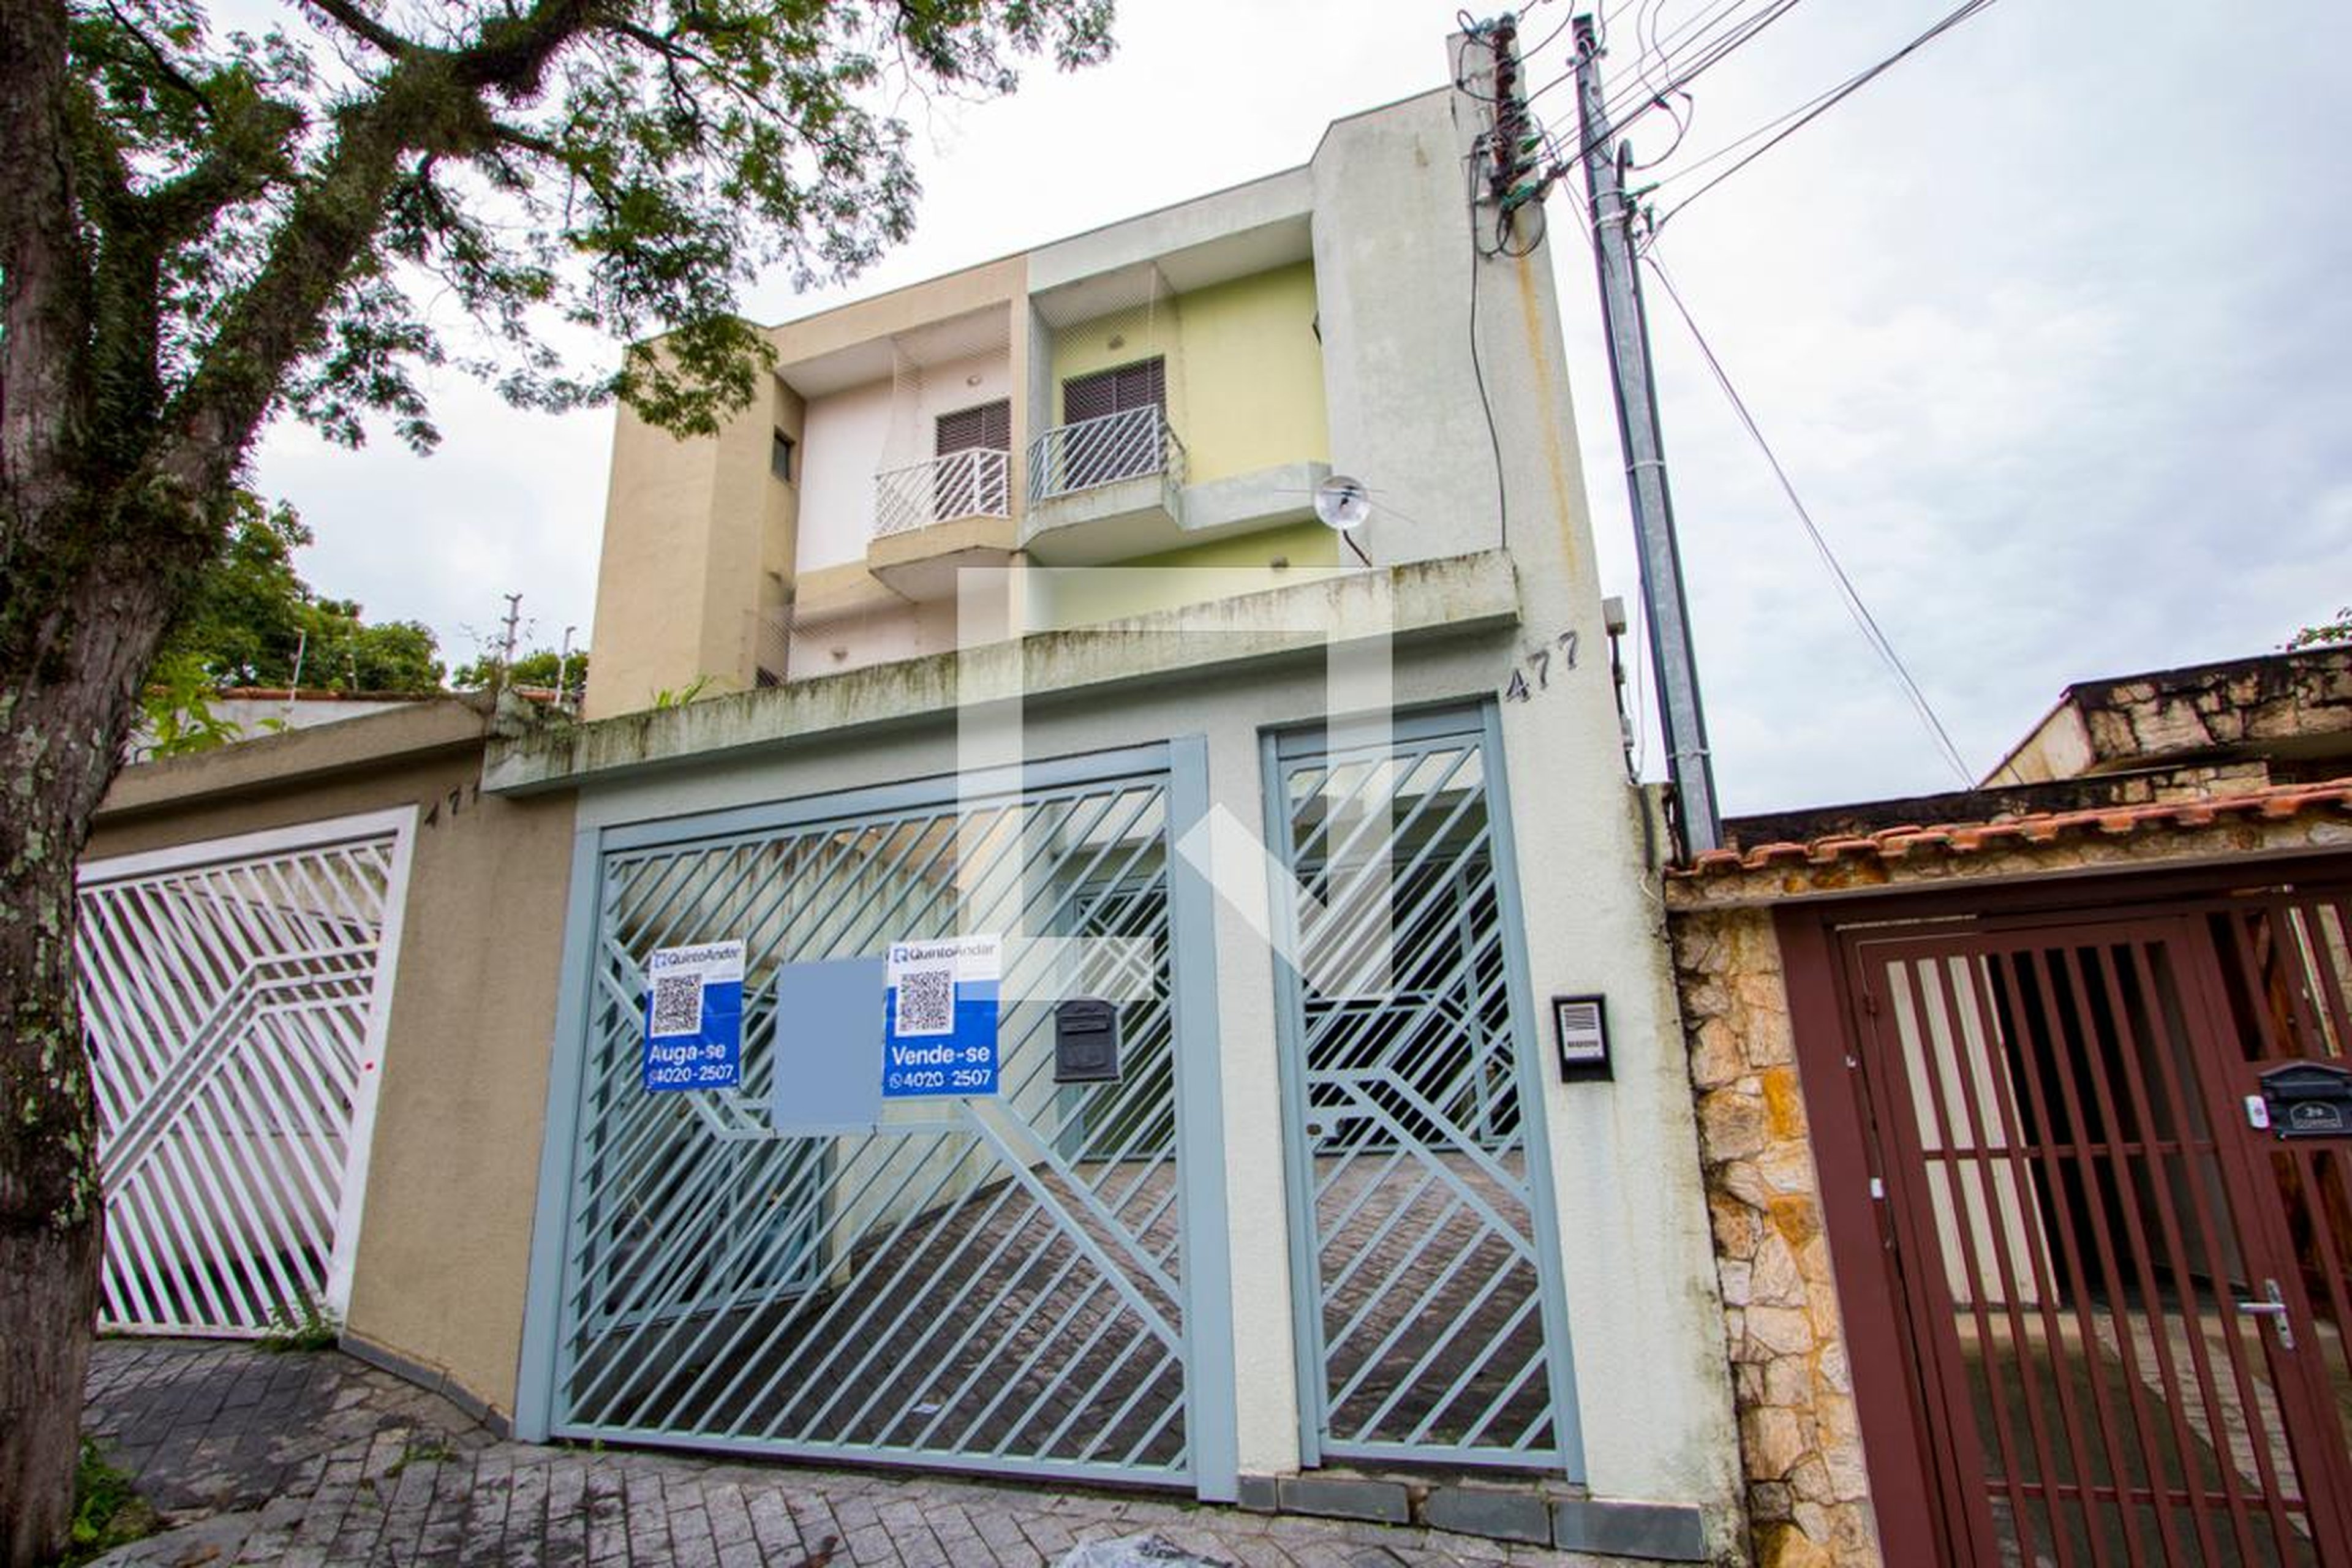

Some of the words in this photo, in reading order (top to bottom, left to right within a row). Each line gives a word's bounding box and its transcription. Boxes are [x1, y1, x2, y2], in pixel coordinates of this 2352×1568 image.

[1506, 630, 1577, 703] 477
[910, 944, 995, 960] QuintoAndar
[892, 1044, 990, 1066] Vende-se
